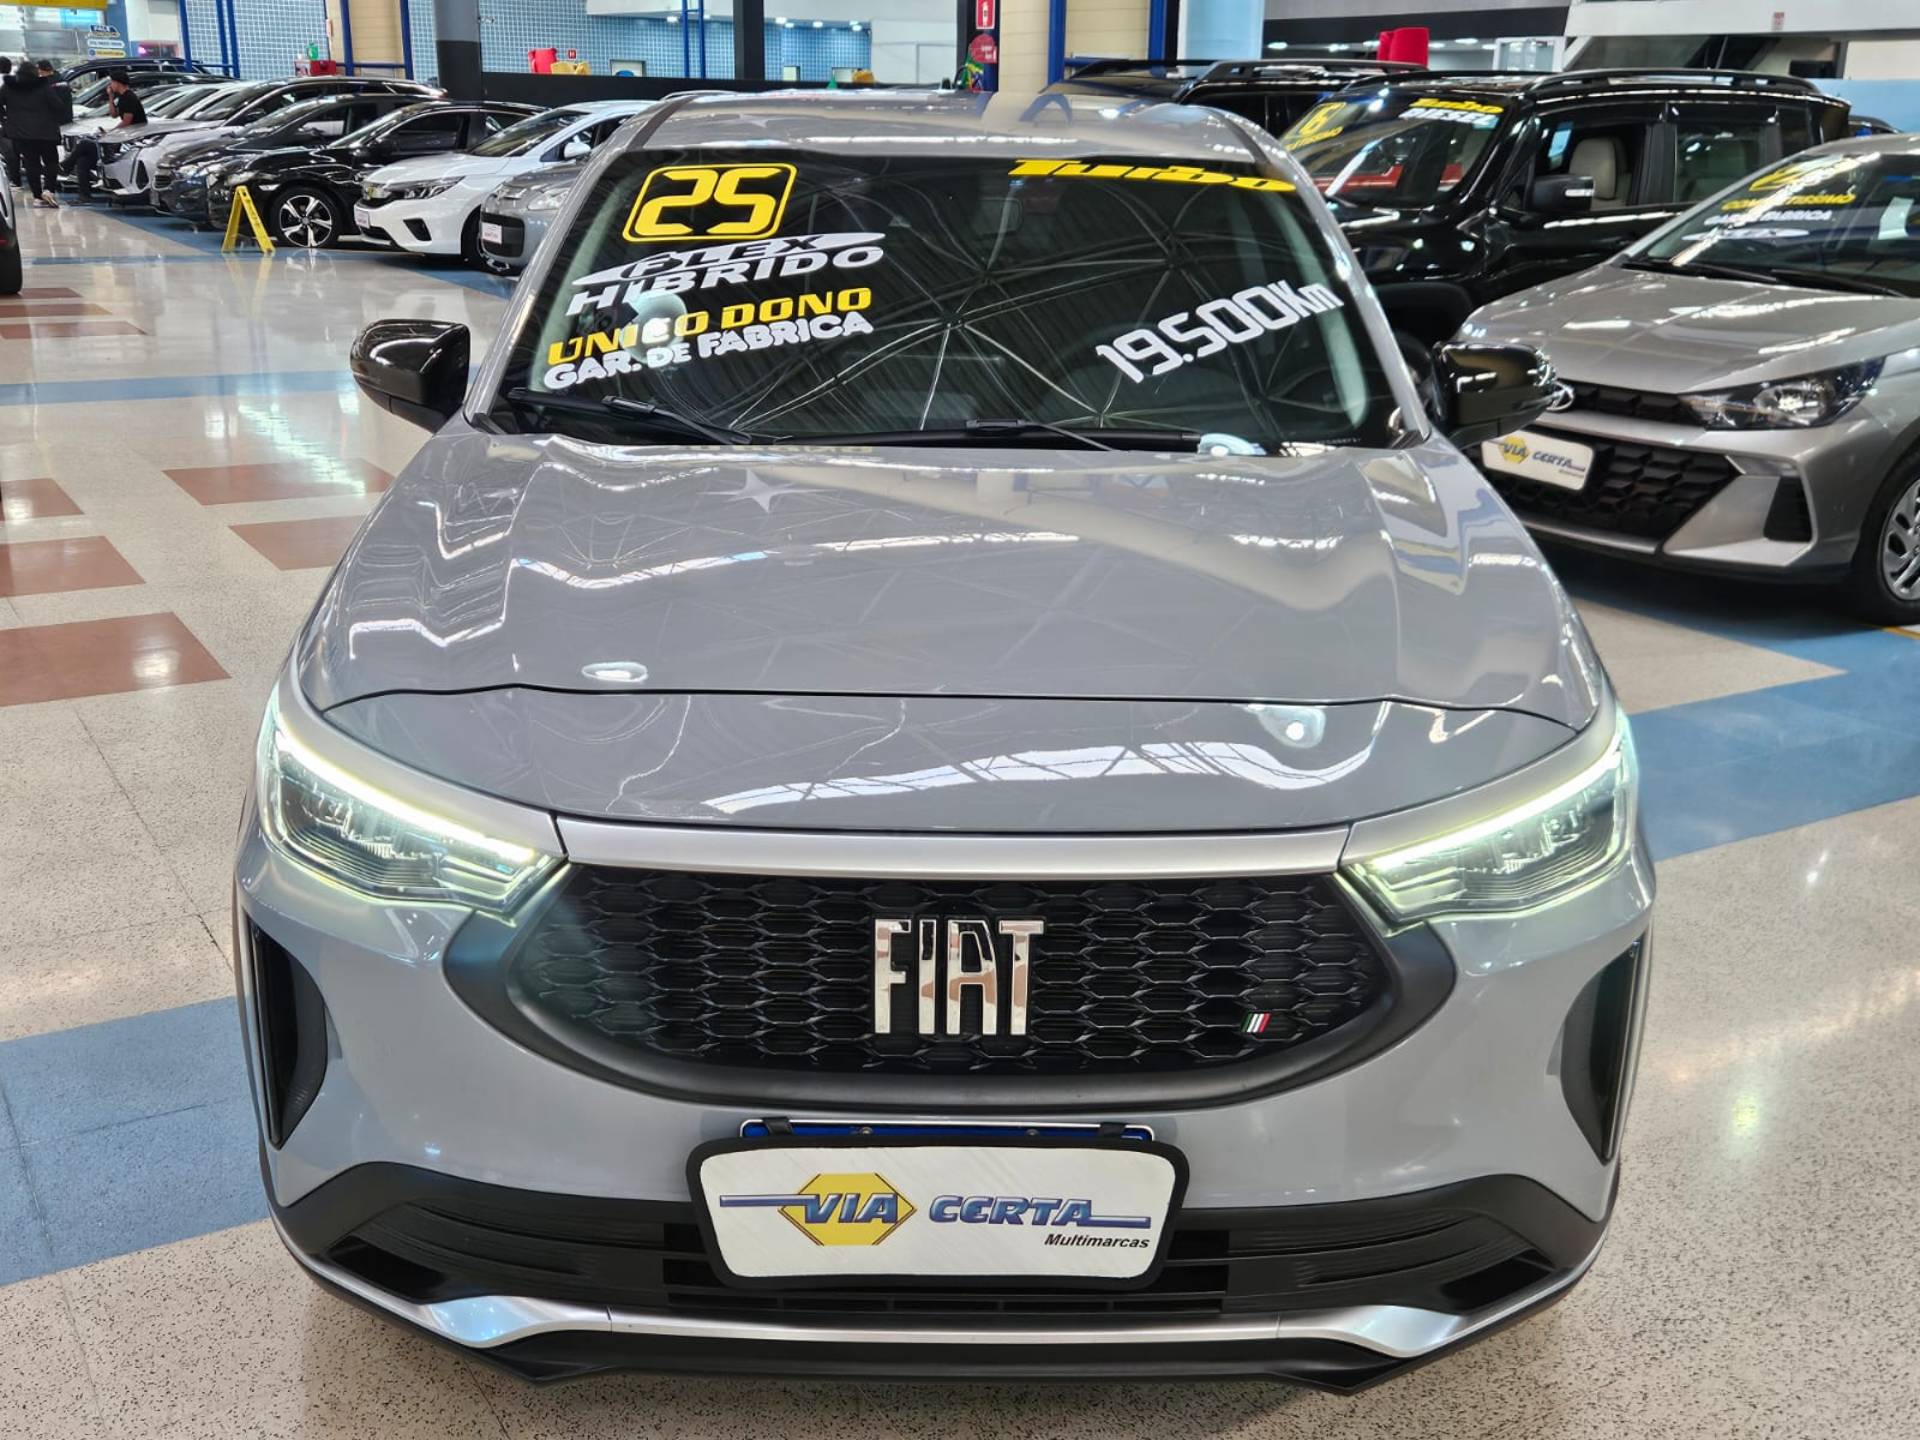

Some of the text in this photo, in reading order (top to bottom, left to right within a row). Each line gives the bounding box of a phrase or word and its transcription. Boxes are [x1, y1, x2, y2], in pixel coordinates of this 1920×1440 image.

[1398, 108, 1498, 127] DIESEL
[1008, 160, 1296, 192] Turbo
[634, 167, 784, 235] 25
[621, 234, 825, 280] FLEX
[720, 287, 872, 329] DONO
[1095, 280, 1345, 384] 19.500Km
[544, 351, 642, 390] GAR.
[647, 342, 692, 369] DE
[1503, 443, 1574, 467] VIA CERTA
[874, 918, 1045, 1036] FIAT
[803, 1193, 1092, 1226] VIA CERTA
[1044, 1233, 1150, 1249] Multimarcas
